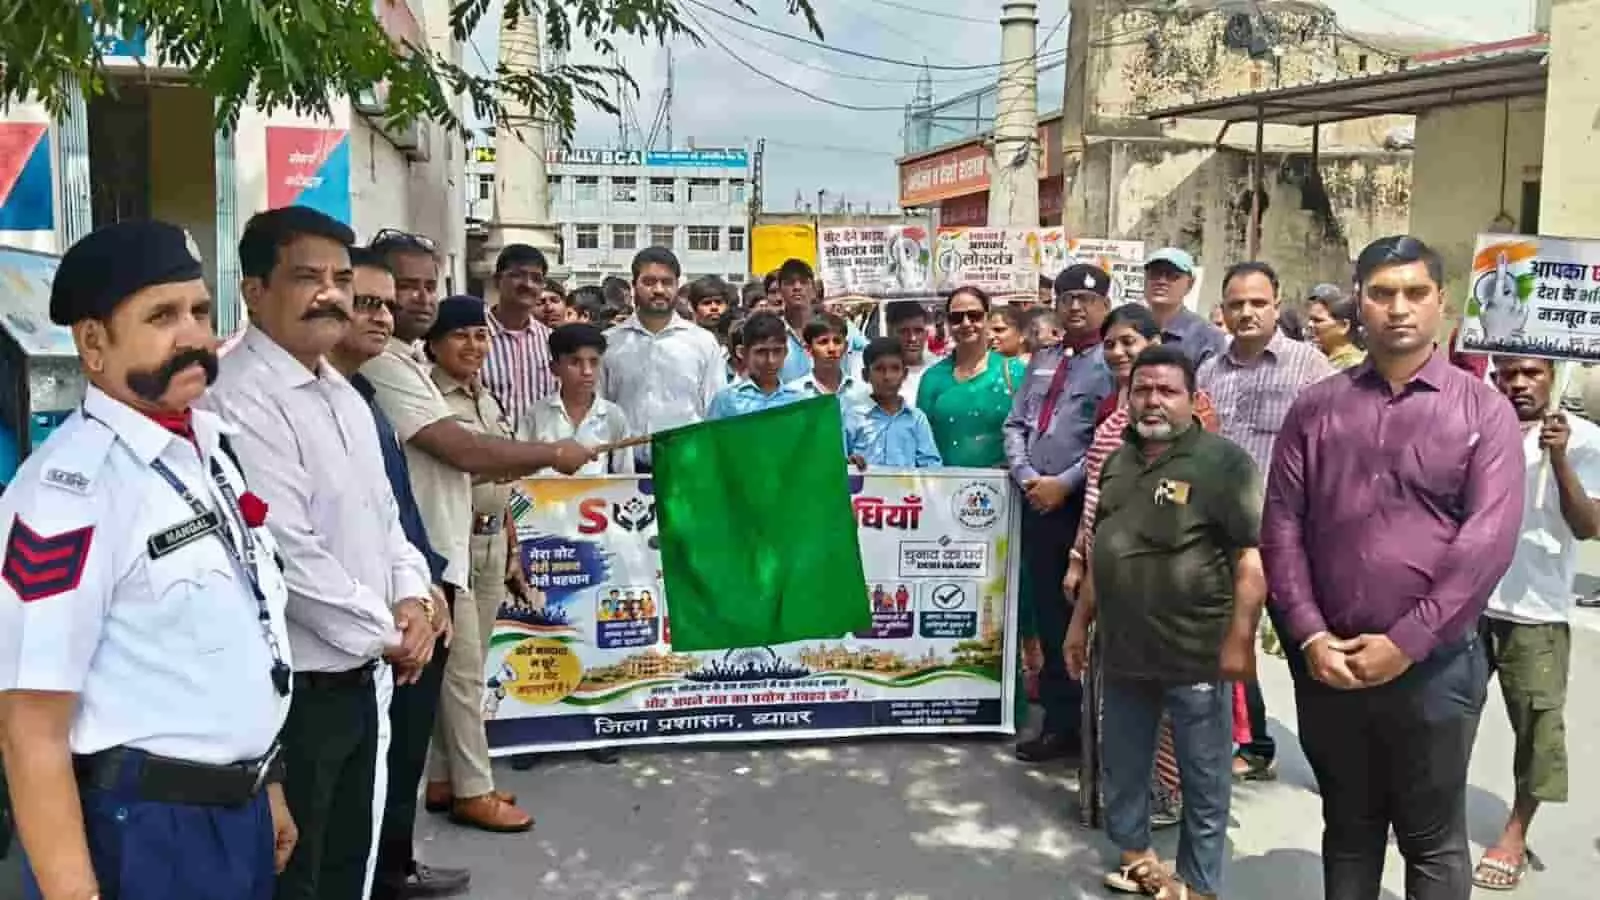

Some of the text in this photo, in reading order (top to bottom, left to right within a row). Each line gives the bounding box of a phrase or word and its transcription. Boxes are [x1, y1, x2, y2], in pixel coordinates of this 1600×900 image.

[561, 150, 600, 164] TALLY
[602, 151, 642, 164] BCA
[825, 244, 885, 257] लोकतंत्र का
[962, 250, 1014, 266] लोकतंत्र
[1531, 261, 1589, 281] आपका
[1537, 282, 1560, 301] देश
[1562, 283, 1578, 301] के
[1537, 307, 1587, 328] मजबूत
[852, 495, 924, 530] धियाँ
[165, 517, 210, 545] MANGAL
[529, 545, 577, 561] मेरा वोट
[904, 550, 939, 565] चुनाव
[552, 573, 591, 587] पहचान
[645, 696, 666, 709] और
[672, 695, 703, 708] अपने
[706, 695, 727, 706] मत
[731, 694, 748, 705] का
[751, 691, 786, 704] प्रयोग
[791, 690, 826, 702] अवश्य
[593, 715, 648, 735] जिला
[657, 712, 743, 733] प्रशासन,
